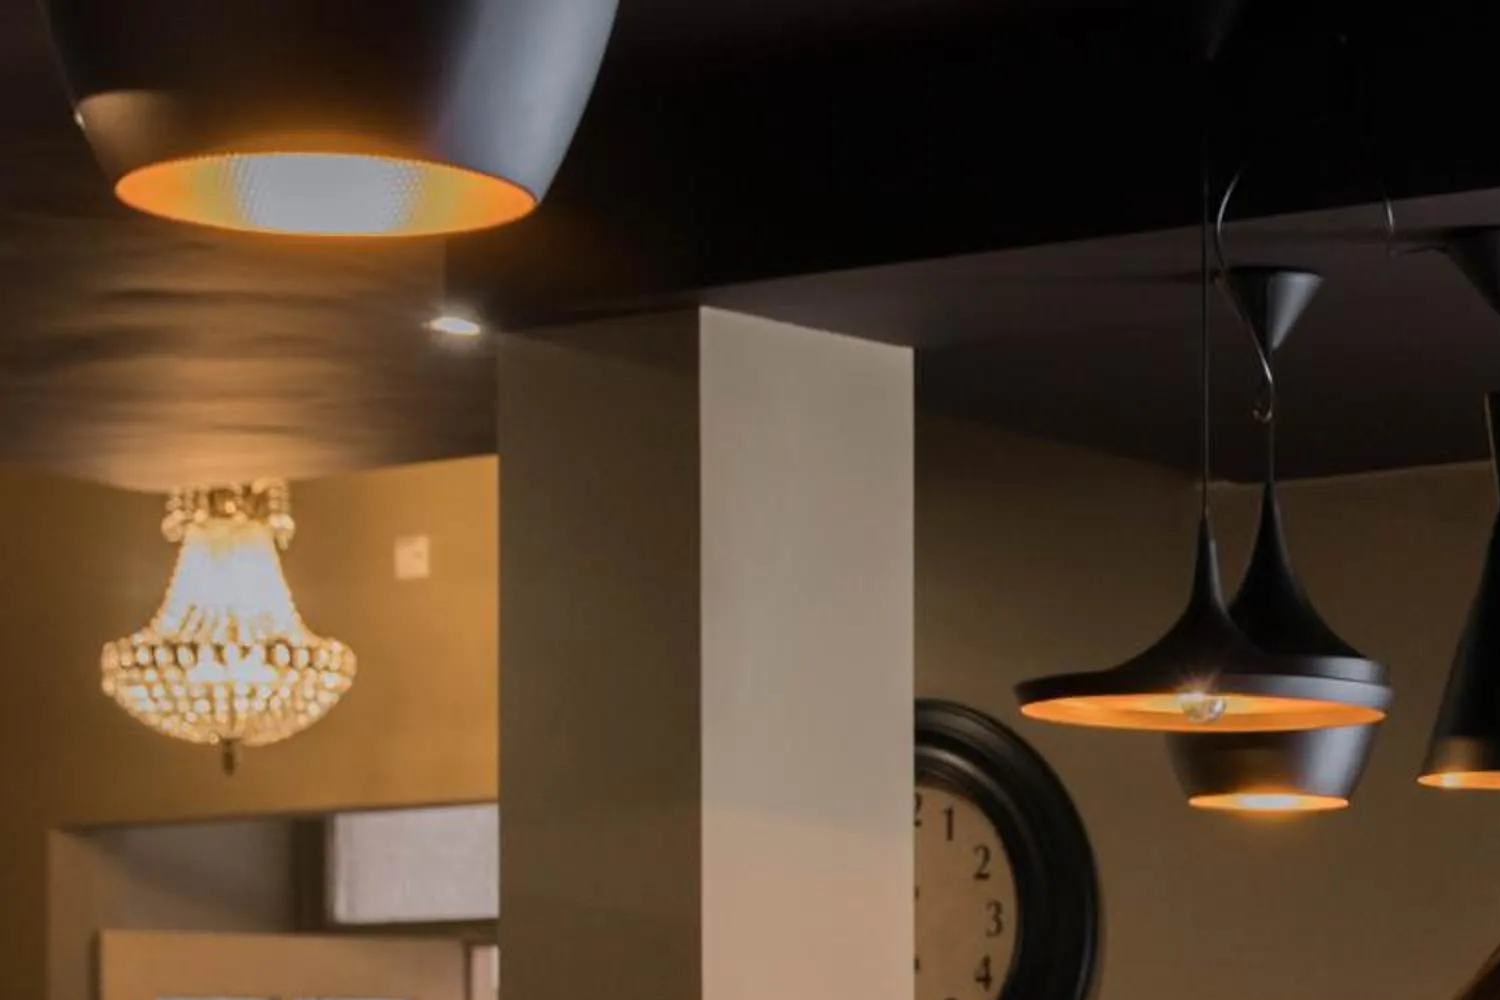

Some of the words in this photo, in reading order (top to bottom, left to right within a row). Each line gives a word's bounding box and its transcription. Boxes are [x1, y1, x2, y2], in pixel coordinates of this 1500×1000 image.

[943, 807, 955, 842] 1
[973, 844, 991, 881] 2
[985, 899, 1003, 938] 3
[974, 954, 992, 992] 4
